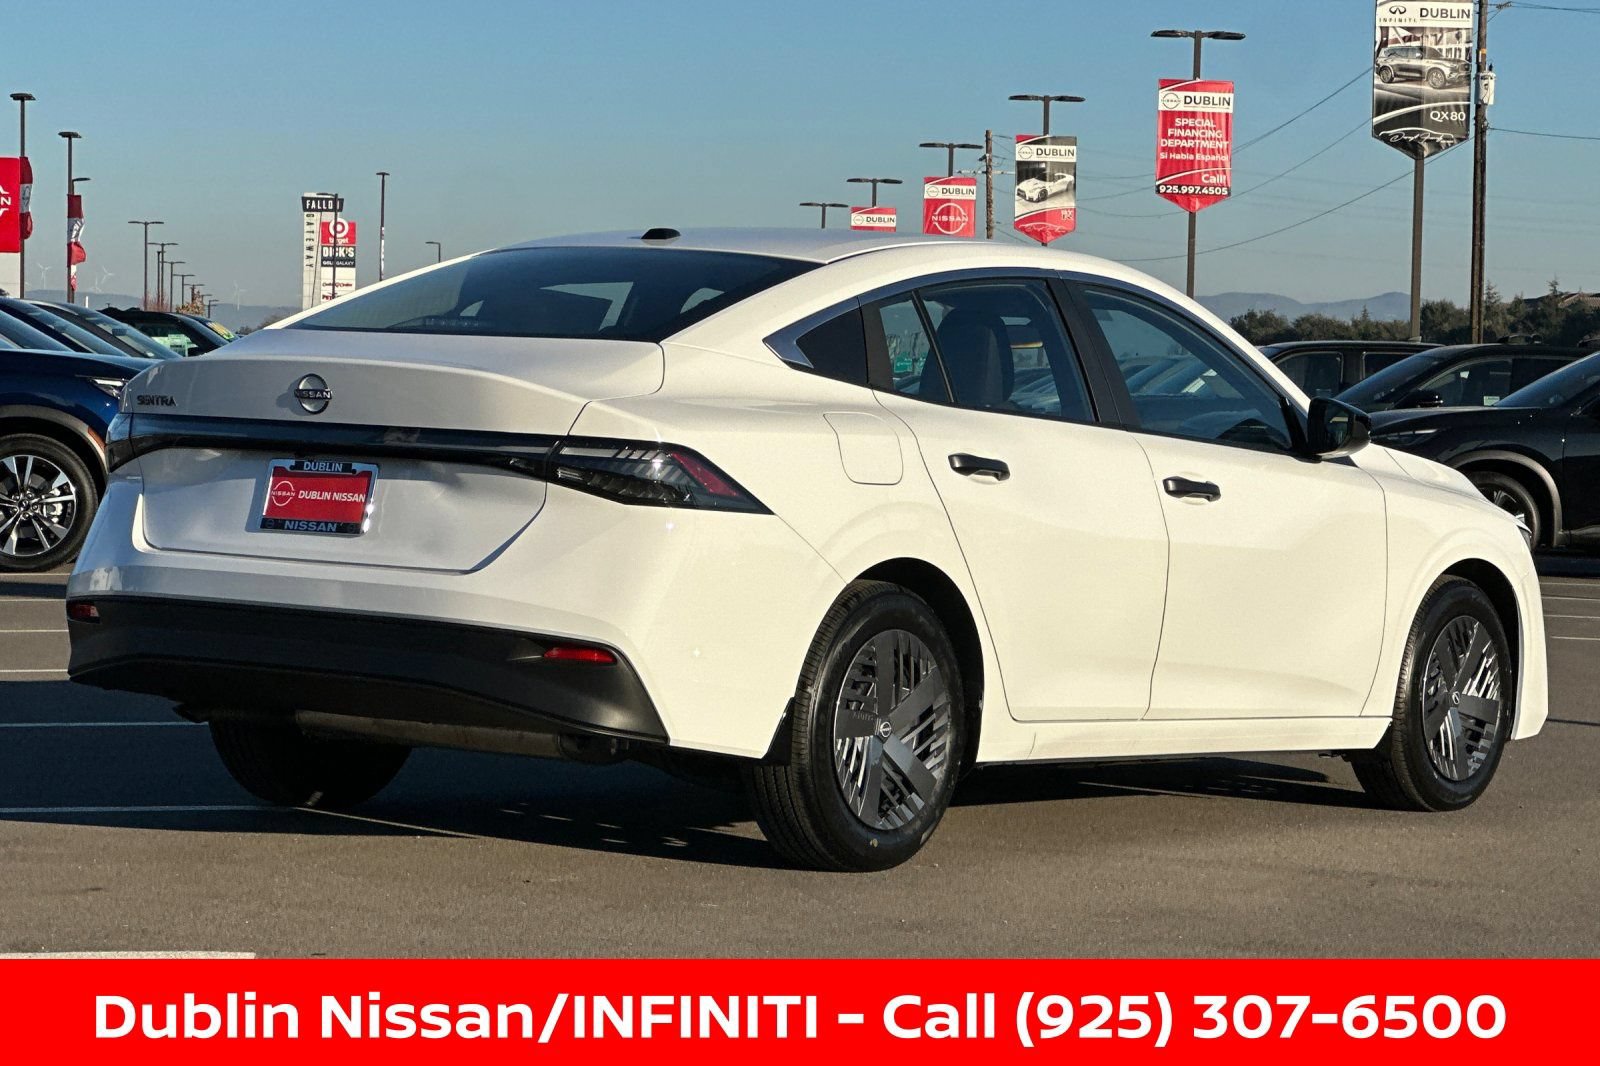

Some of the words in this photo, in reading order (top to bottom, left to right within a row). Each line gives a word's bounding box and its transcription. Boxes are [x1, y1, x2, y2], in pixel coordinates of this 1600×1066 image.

[1419, 7, 1471, 18] DUBLIN
[1184, 95, 1231, 106] DUBLIN
[1430, 111, 1466, 122] QX80
[1175, 118, 1216, 127] SPECIAL
[1168, 128, 1223, 138] FINANCING
[1160, 139, 1230, 149] DEPARTMENT
[1036, 148, 1075, 157] DUBLIN
[1170, 152, 1195, 160] Habla
[941, 187, 975, 195] DUBLIN
[1159, 185, 1228, 195] 925.997.4505
[305, 213, 315, 268] GATEWAY
[136, 394, 177, 407] SENTRA
[303, 461, 343, 472] DUBLIN
[298, 490, 331, 500] DUBLIN
[332, 493, 366, 502] NISSAN
[284, 521, 337, 532] NISSAN
